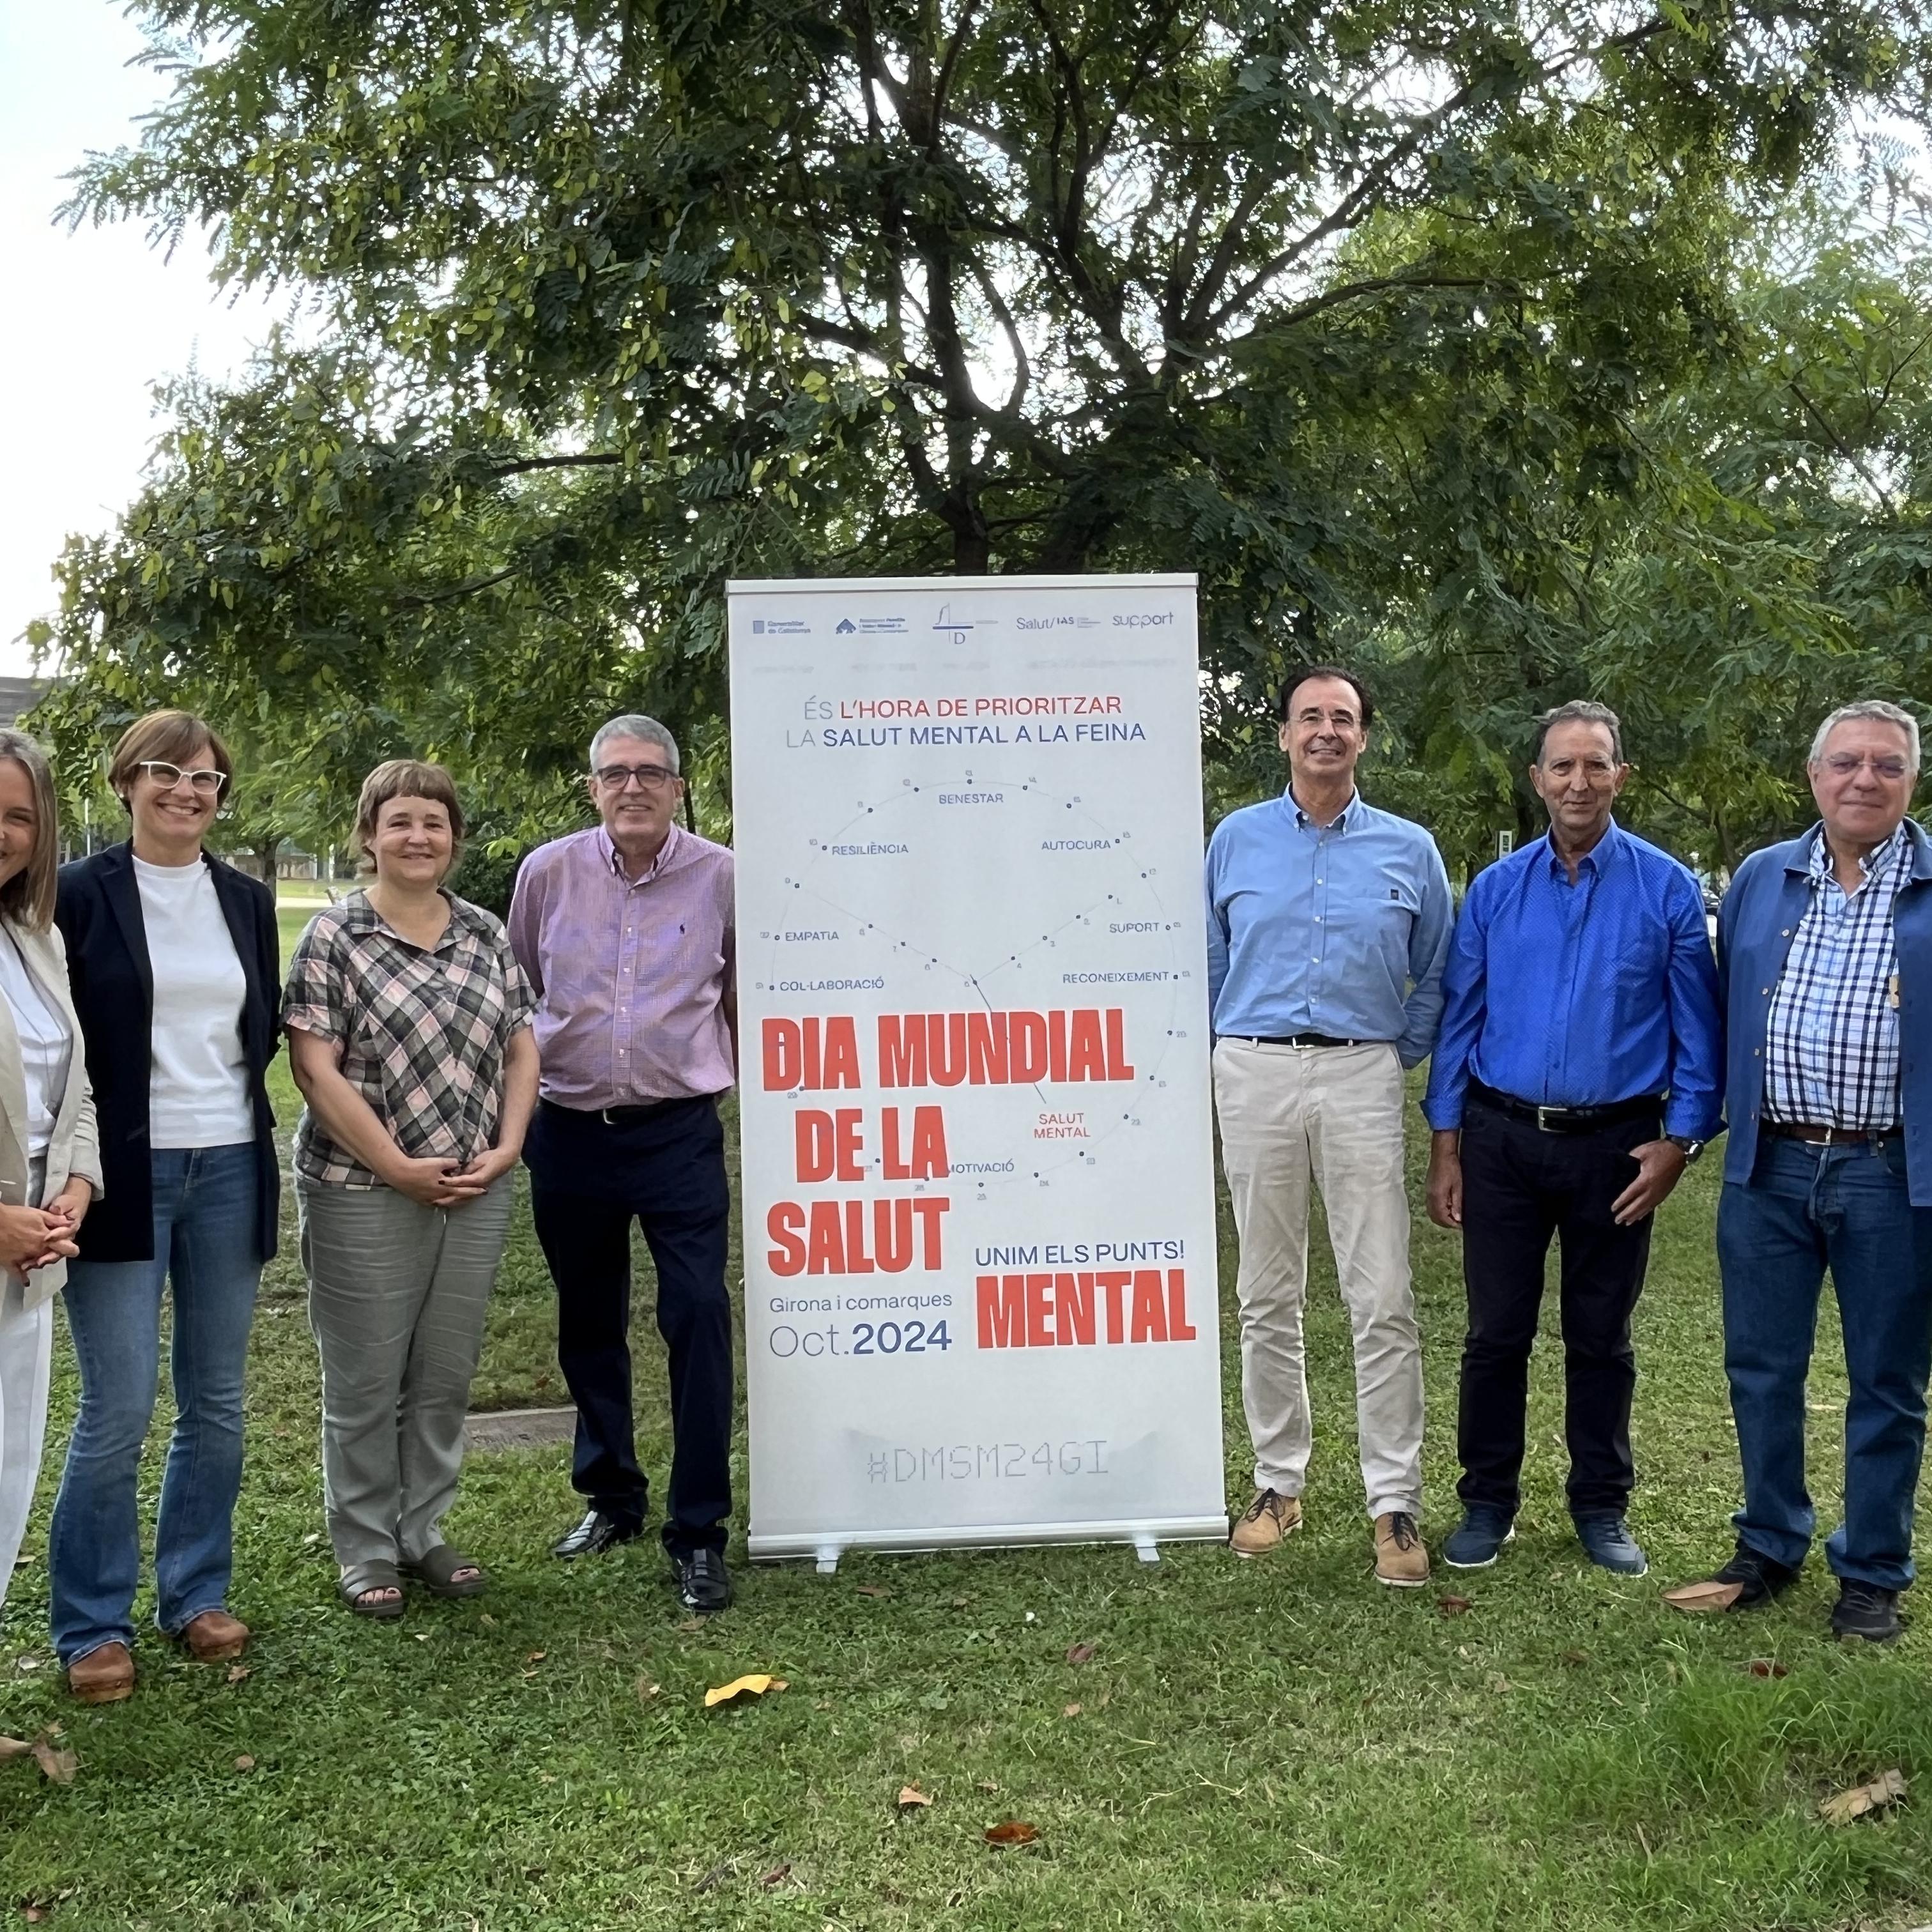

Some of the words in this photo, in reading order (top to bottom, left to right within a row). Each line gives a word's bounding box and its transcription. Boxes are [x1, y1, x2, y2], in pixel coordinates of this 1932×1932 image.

[1112, 612, 1174, 628] support
[805, 695, 832, 719] ÉS
[841, 700, 930, 719] L'HORA
[938, 699, 968, 716] DE
[976, 696, 1121, 716] PRIORITZAR
[787, 730, 815, 747] LA
[824, 728, 902, 747] SALUT
[910, 726, 1008, 744] MENTAL
[1015, 725, 1032, 743] A
[1039, 725, 1068, 742] LA
[1076, 723, 1146, 741] FEINA
[939, 793, 1003, 804] BENESTAR
[832, 842, 908, 855] RESILIÈNCIA
[1041, 840, 1110, 850] AUTOCURA
[786, 931, 839, 941] EMPATIA
[1110, 923, 1160, 933] SUPORT
[1063, 972, 1169, 983] RECONEIXEMENT
[762, 1017, 860, 1091] DIA
[878, 1009, 1133, 1086] MUNDIAL
[1039, 1113, 1084, 1124] SALUT
[1034, 1127, 1091, 1138] MENTAL
[796, 1109, 863, 1182] DE
[882, 1107, 949, 1181] LA
[767, 1198, 949, 1276] SALUT
[976, 1246, 1038, 1266] UNIM
[1046, 1245, 1089, 1264] ELS
[1096, 1239, 1184, 1262] PUNTS!
[770, 1298, 832, 1312] Girona
[837, 1295, 840, 1310] i
[846, 1295, 952, 1310] comarques
[977, 1269, 1195, 1348] MENTAL
[867, 1441, 1108, 1483] #DMSM24GI
